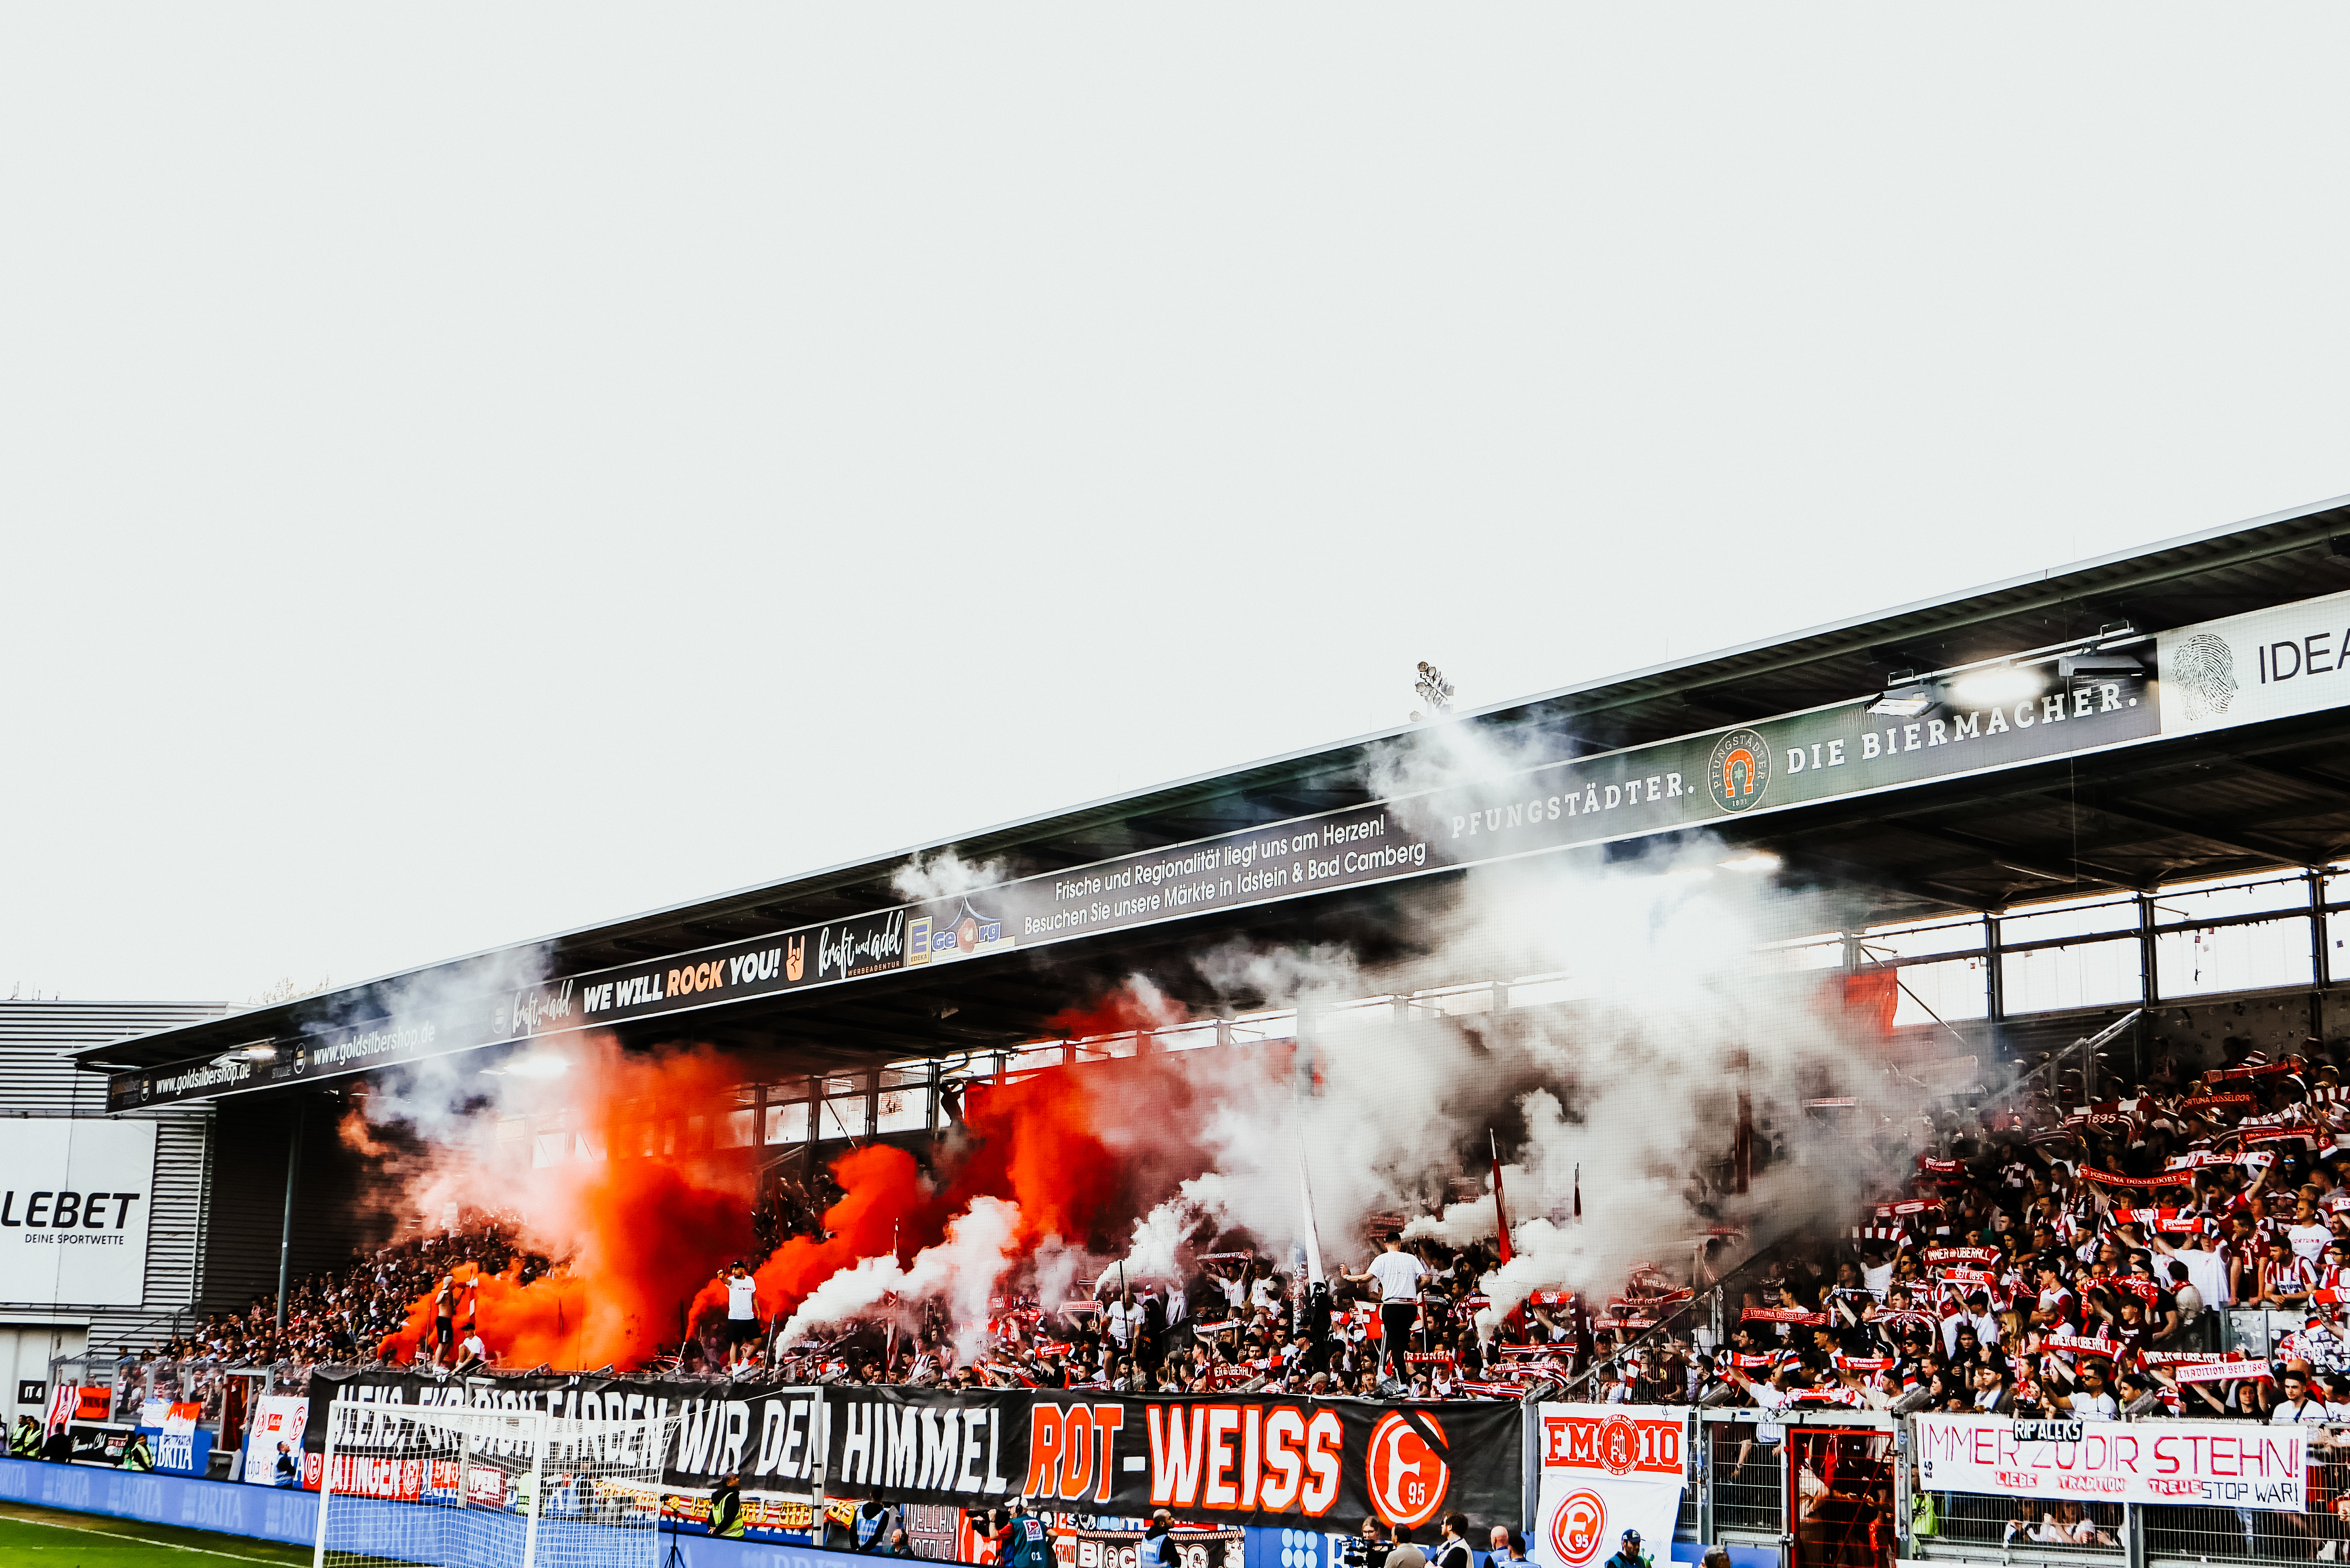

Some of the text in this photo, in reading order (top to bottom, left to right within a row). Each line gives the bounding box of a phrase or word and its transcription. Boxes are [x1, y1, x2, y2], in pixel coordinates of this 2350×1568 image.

[1786, 683, 2137, 774] DIE BIERMACHER.
[1713, 735, 1766, 789] PFUNGSTÄDTER
[1452, 772, 1694, 838] PFUNGSTÄDTER.
[1056, 815, 1384, 900] Frische und Regionalität liegt uns am Herzen!
[1025, 842, 1426, 935] Besuchen Sie unsere Märkte in Idstein & Bad Camberg
[819, 927, 854, 979] kraft
[855, 929, 871, 955] und
[872, 910, 904, 960] adel
[911, 954, 928, 962] EDEKA
[584, 948, 781, 1013] WE WILL ROCK YOU!
[848, 961, 900, 977] WERBEAGENTUR
[314, 1022, 434, 1066] www.goldsilbershop.de
[156, 1064, 250, 1095] www.goldsilbershop.de
[1, 1191, 140, 1228] LEBET
[25, 1234, 124, 1245] DEINE SPORTWETTE
[1955, 1269, 1985, 1281] SEIT 1895
[1750, 1310, 1775, 1318] FORTUNA
[1547, 1423, 1679, 1467] FM 10
[1922, 1423, 2020, 1466] IMMER
[2086, 1435, 2138, 1473] DIR
[2154, 1436, 2299, 1478] STEHN!
[2015, 1421, 2082, 1440] RIP ALEKS
[676, 1398, 751, 1475] WIR
[842, 1402, 1007, 1494] HIMMEL
[1021, 1402, 1344, 1517] ROT-WEISS
[1408, 1482, 1425, 1505] 95
[1996, 1471, 2201, 1494] LIEBE TRADITION TREUE
[2202, 1482, 2299, 1506] STOP WAR!
[282, 1496, 319, 1539] BRIT
[1031, 1551, 1042, 1561] 01
